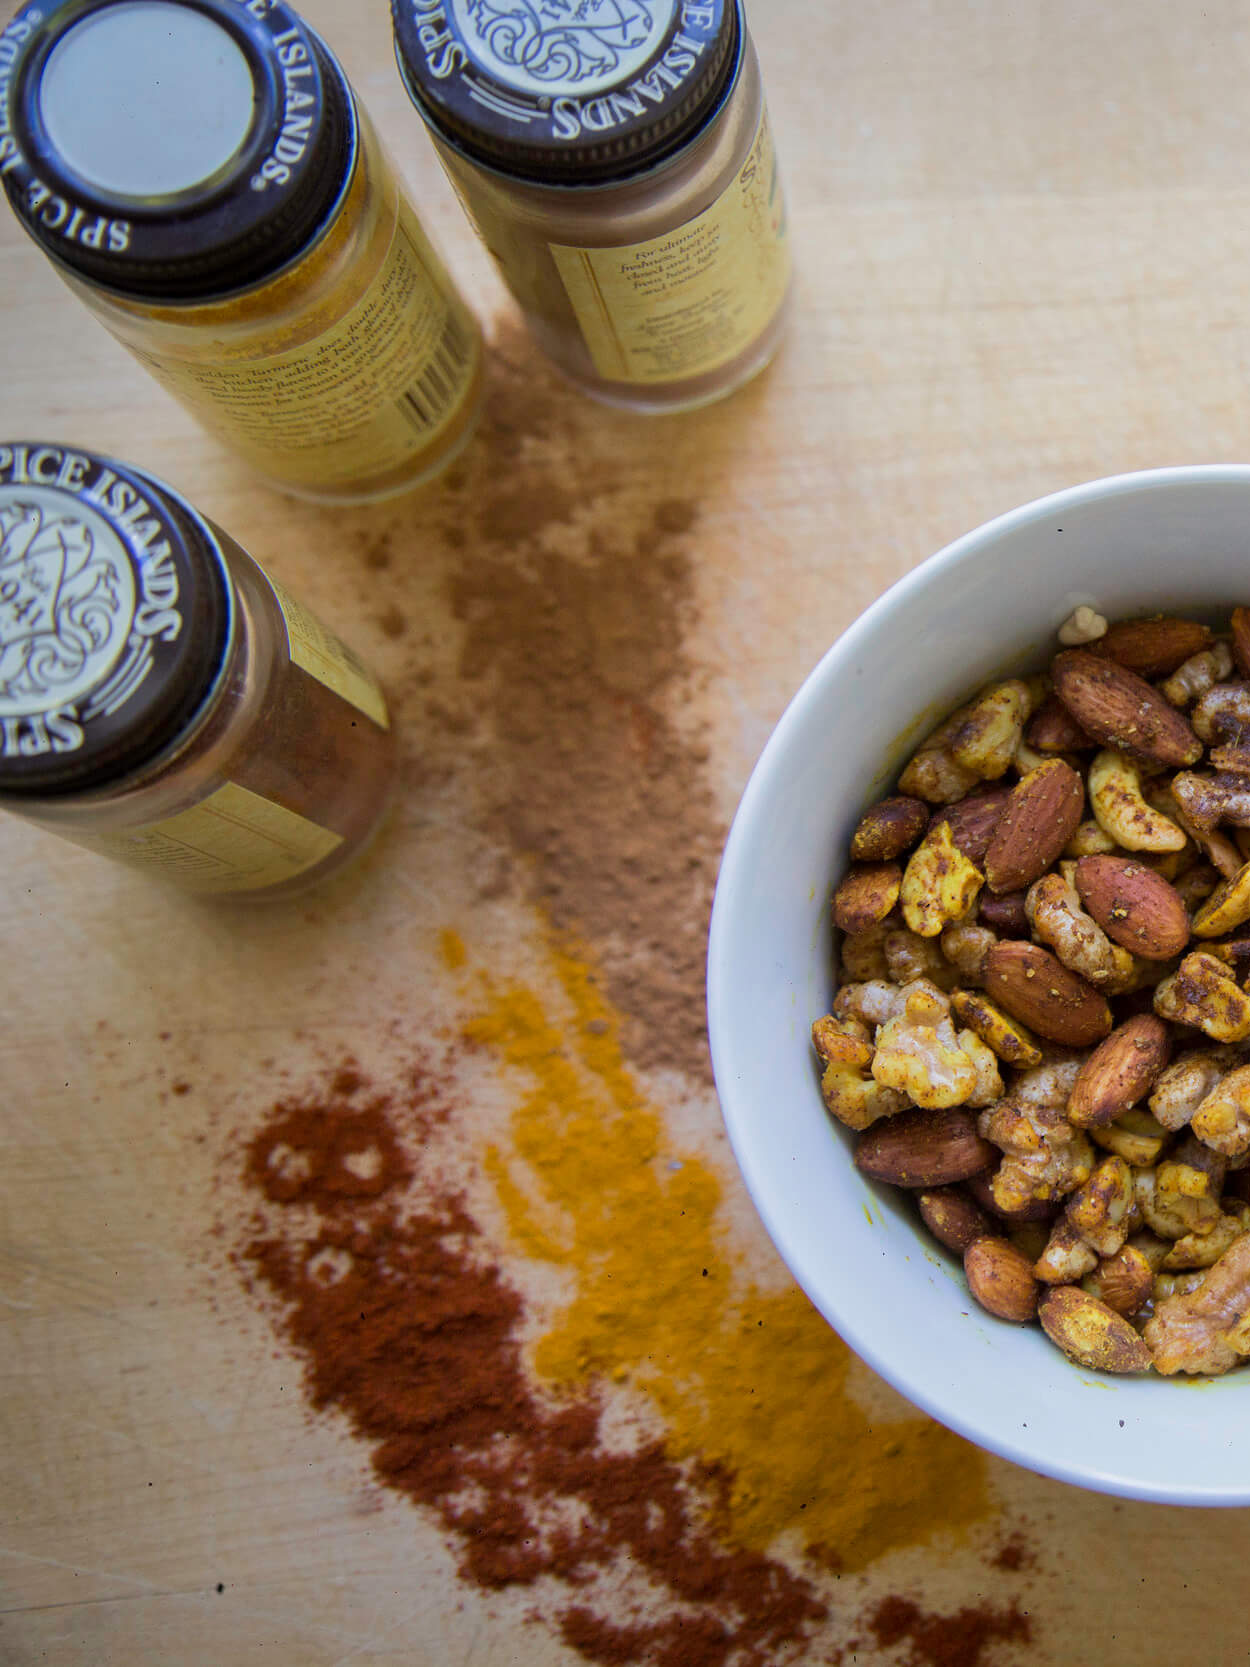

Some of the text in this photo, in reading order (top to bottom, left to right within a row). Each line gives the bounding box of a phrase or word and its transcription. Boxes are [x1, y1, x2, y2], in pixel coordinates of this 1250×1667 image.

[415, 0, 469, 80] SPI
[261, 26, 314, 185] ISLANDS
[552, 31, 705, 140] ISLANDS
[28, 178, 131, 252] SPICE
[659, 224, 707, 252] ultimate
[666, 253, 690, 270] and
[0, 447, 90, 492] PICE
[91, 468, 183, 642] ISLANDS
[0, 704, 84, 757] SPI
